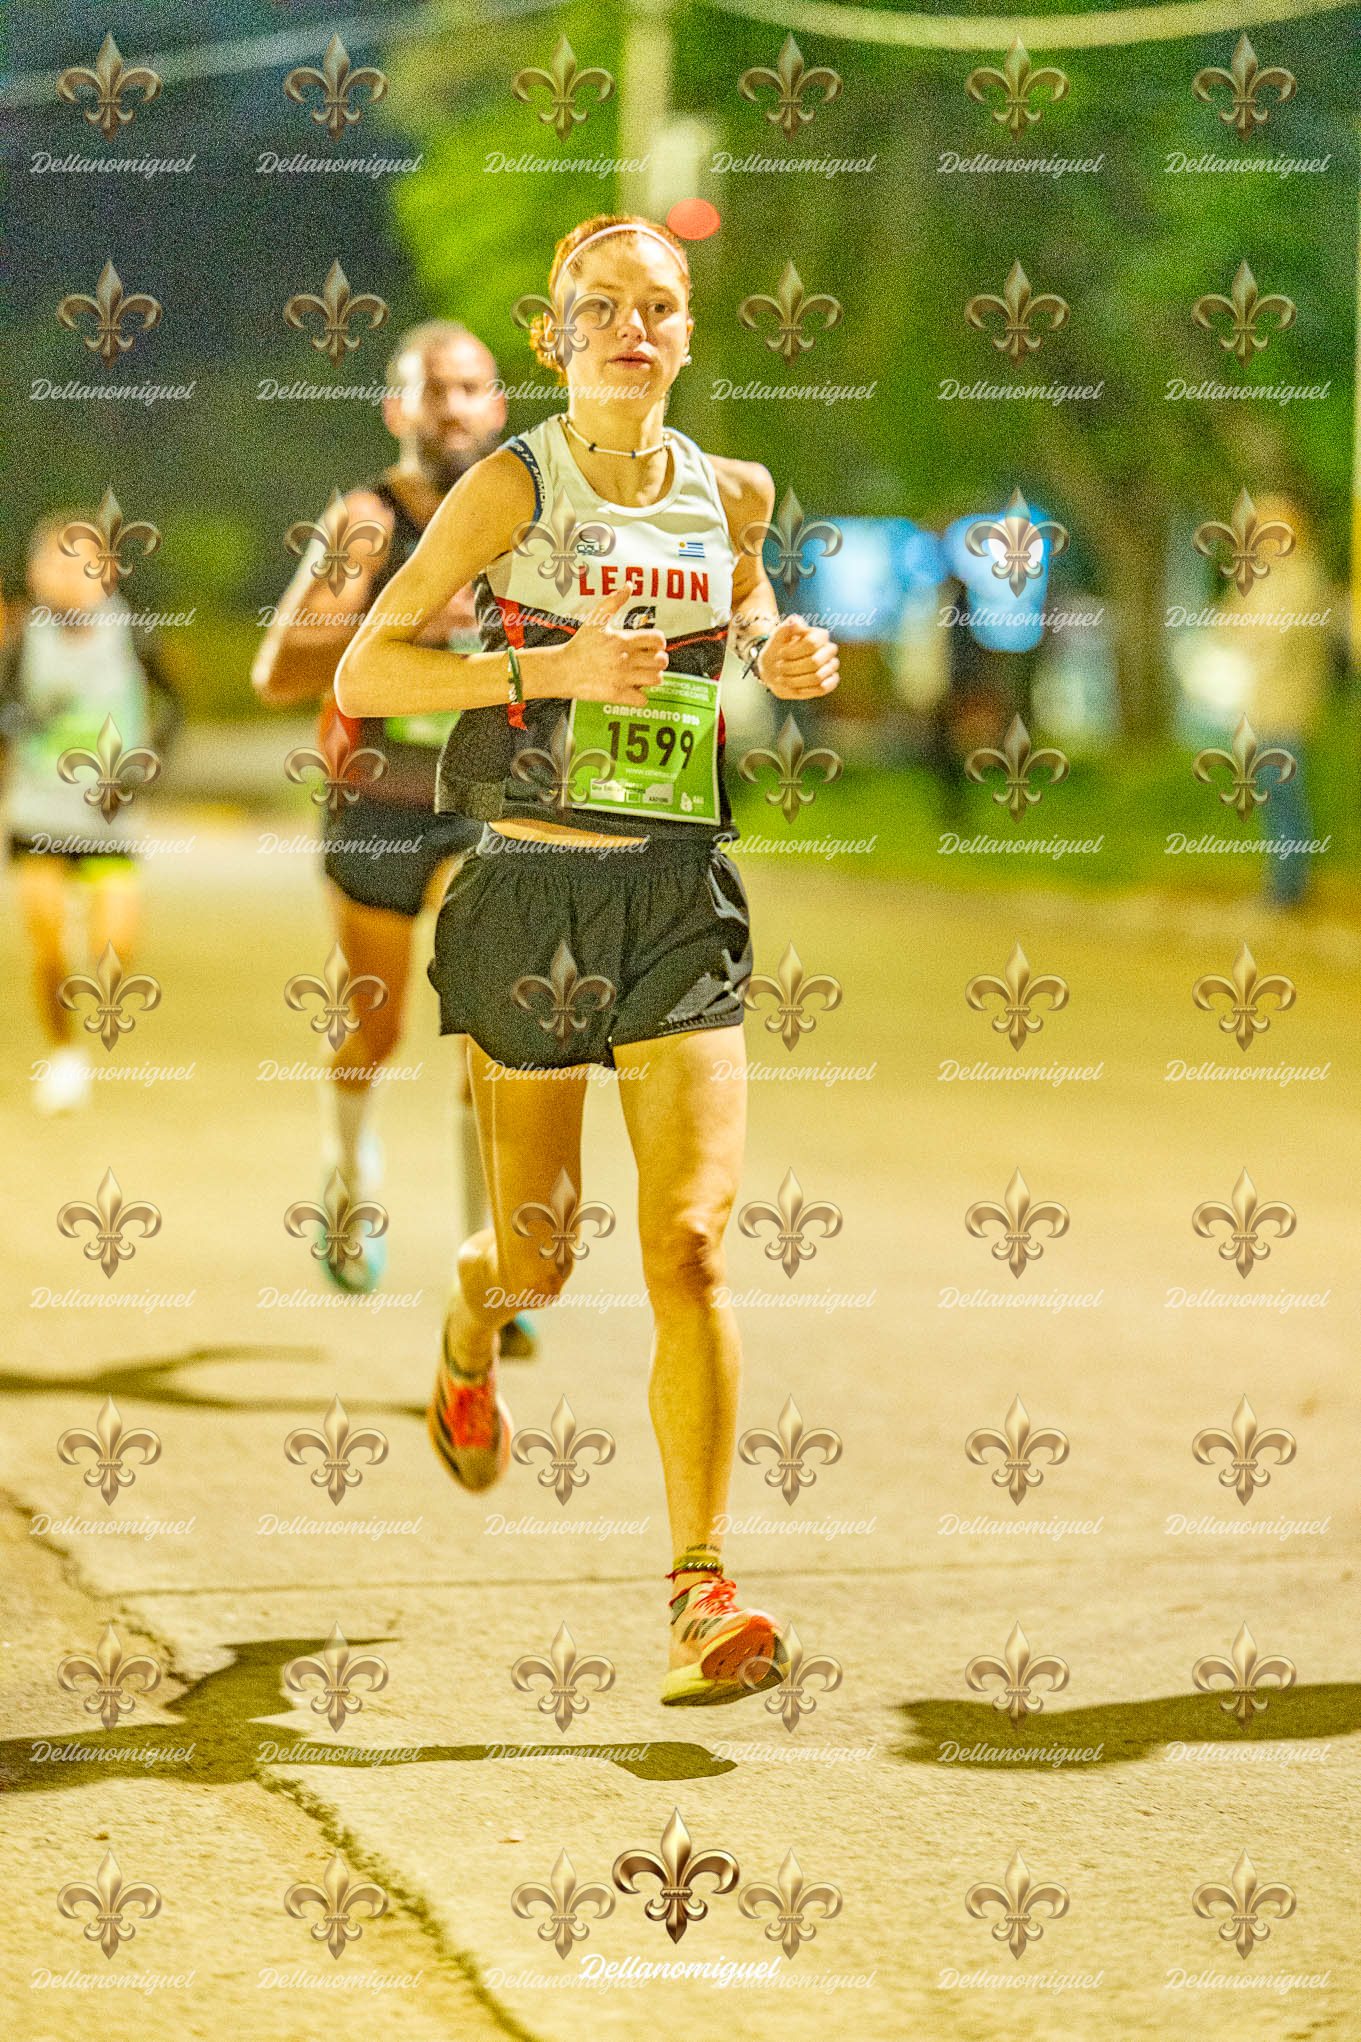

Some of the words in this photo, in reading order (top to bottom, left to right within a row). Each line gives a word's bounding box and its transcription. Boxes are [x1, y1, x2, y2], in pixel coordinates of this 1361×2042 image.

[578, 565, 709, 603] LEGION
[603, 704, 681, 721] CAMPEONATO
[607, 721, 694, 769] 1599
